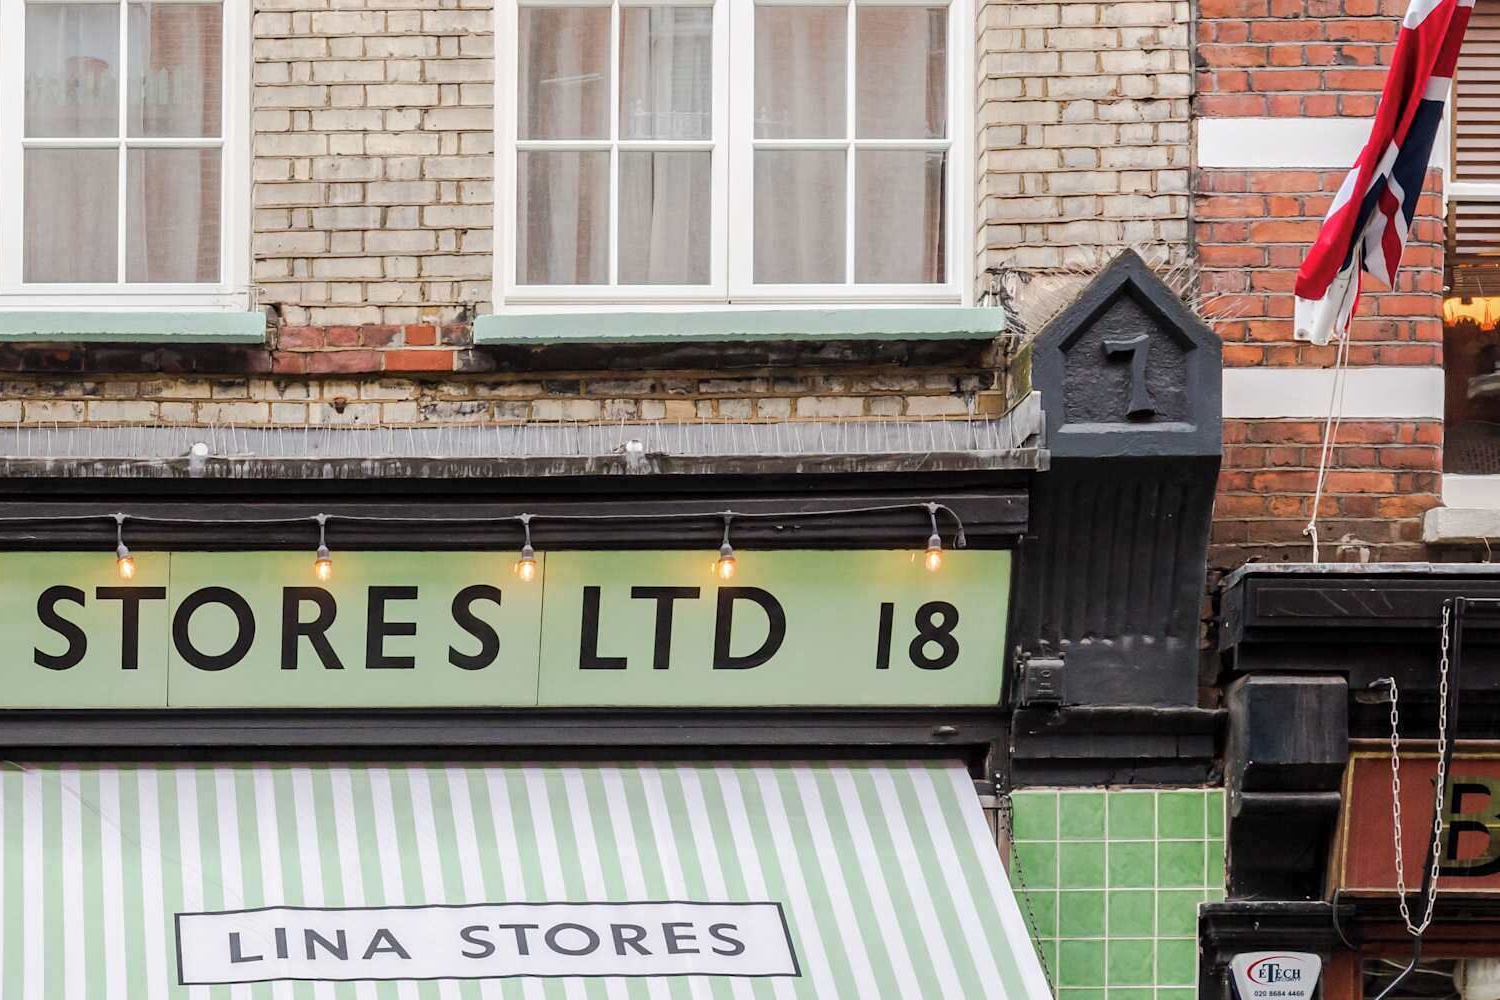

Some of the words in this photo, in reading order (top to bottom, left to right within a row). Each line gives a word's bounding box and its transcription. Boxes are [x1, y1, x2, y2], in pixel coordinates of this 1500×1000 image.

[33, 584, 503, 672] STORES
[578, 586, 788, 671] LTD
[875, 600, 961, 671] 18
[229, 926, 412, 965] LINA
[461, 922, 748, 960] STORES
